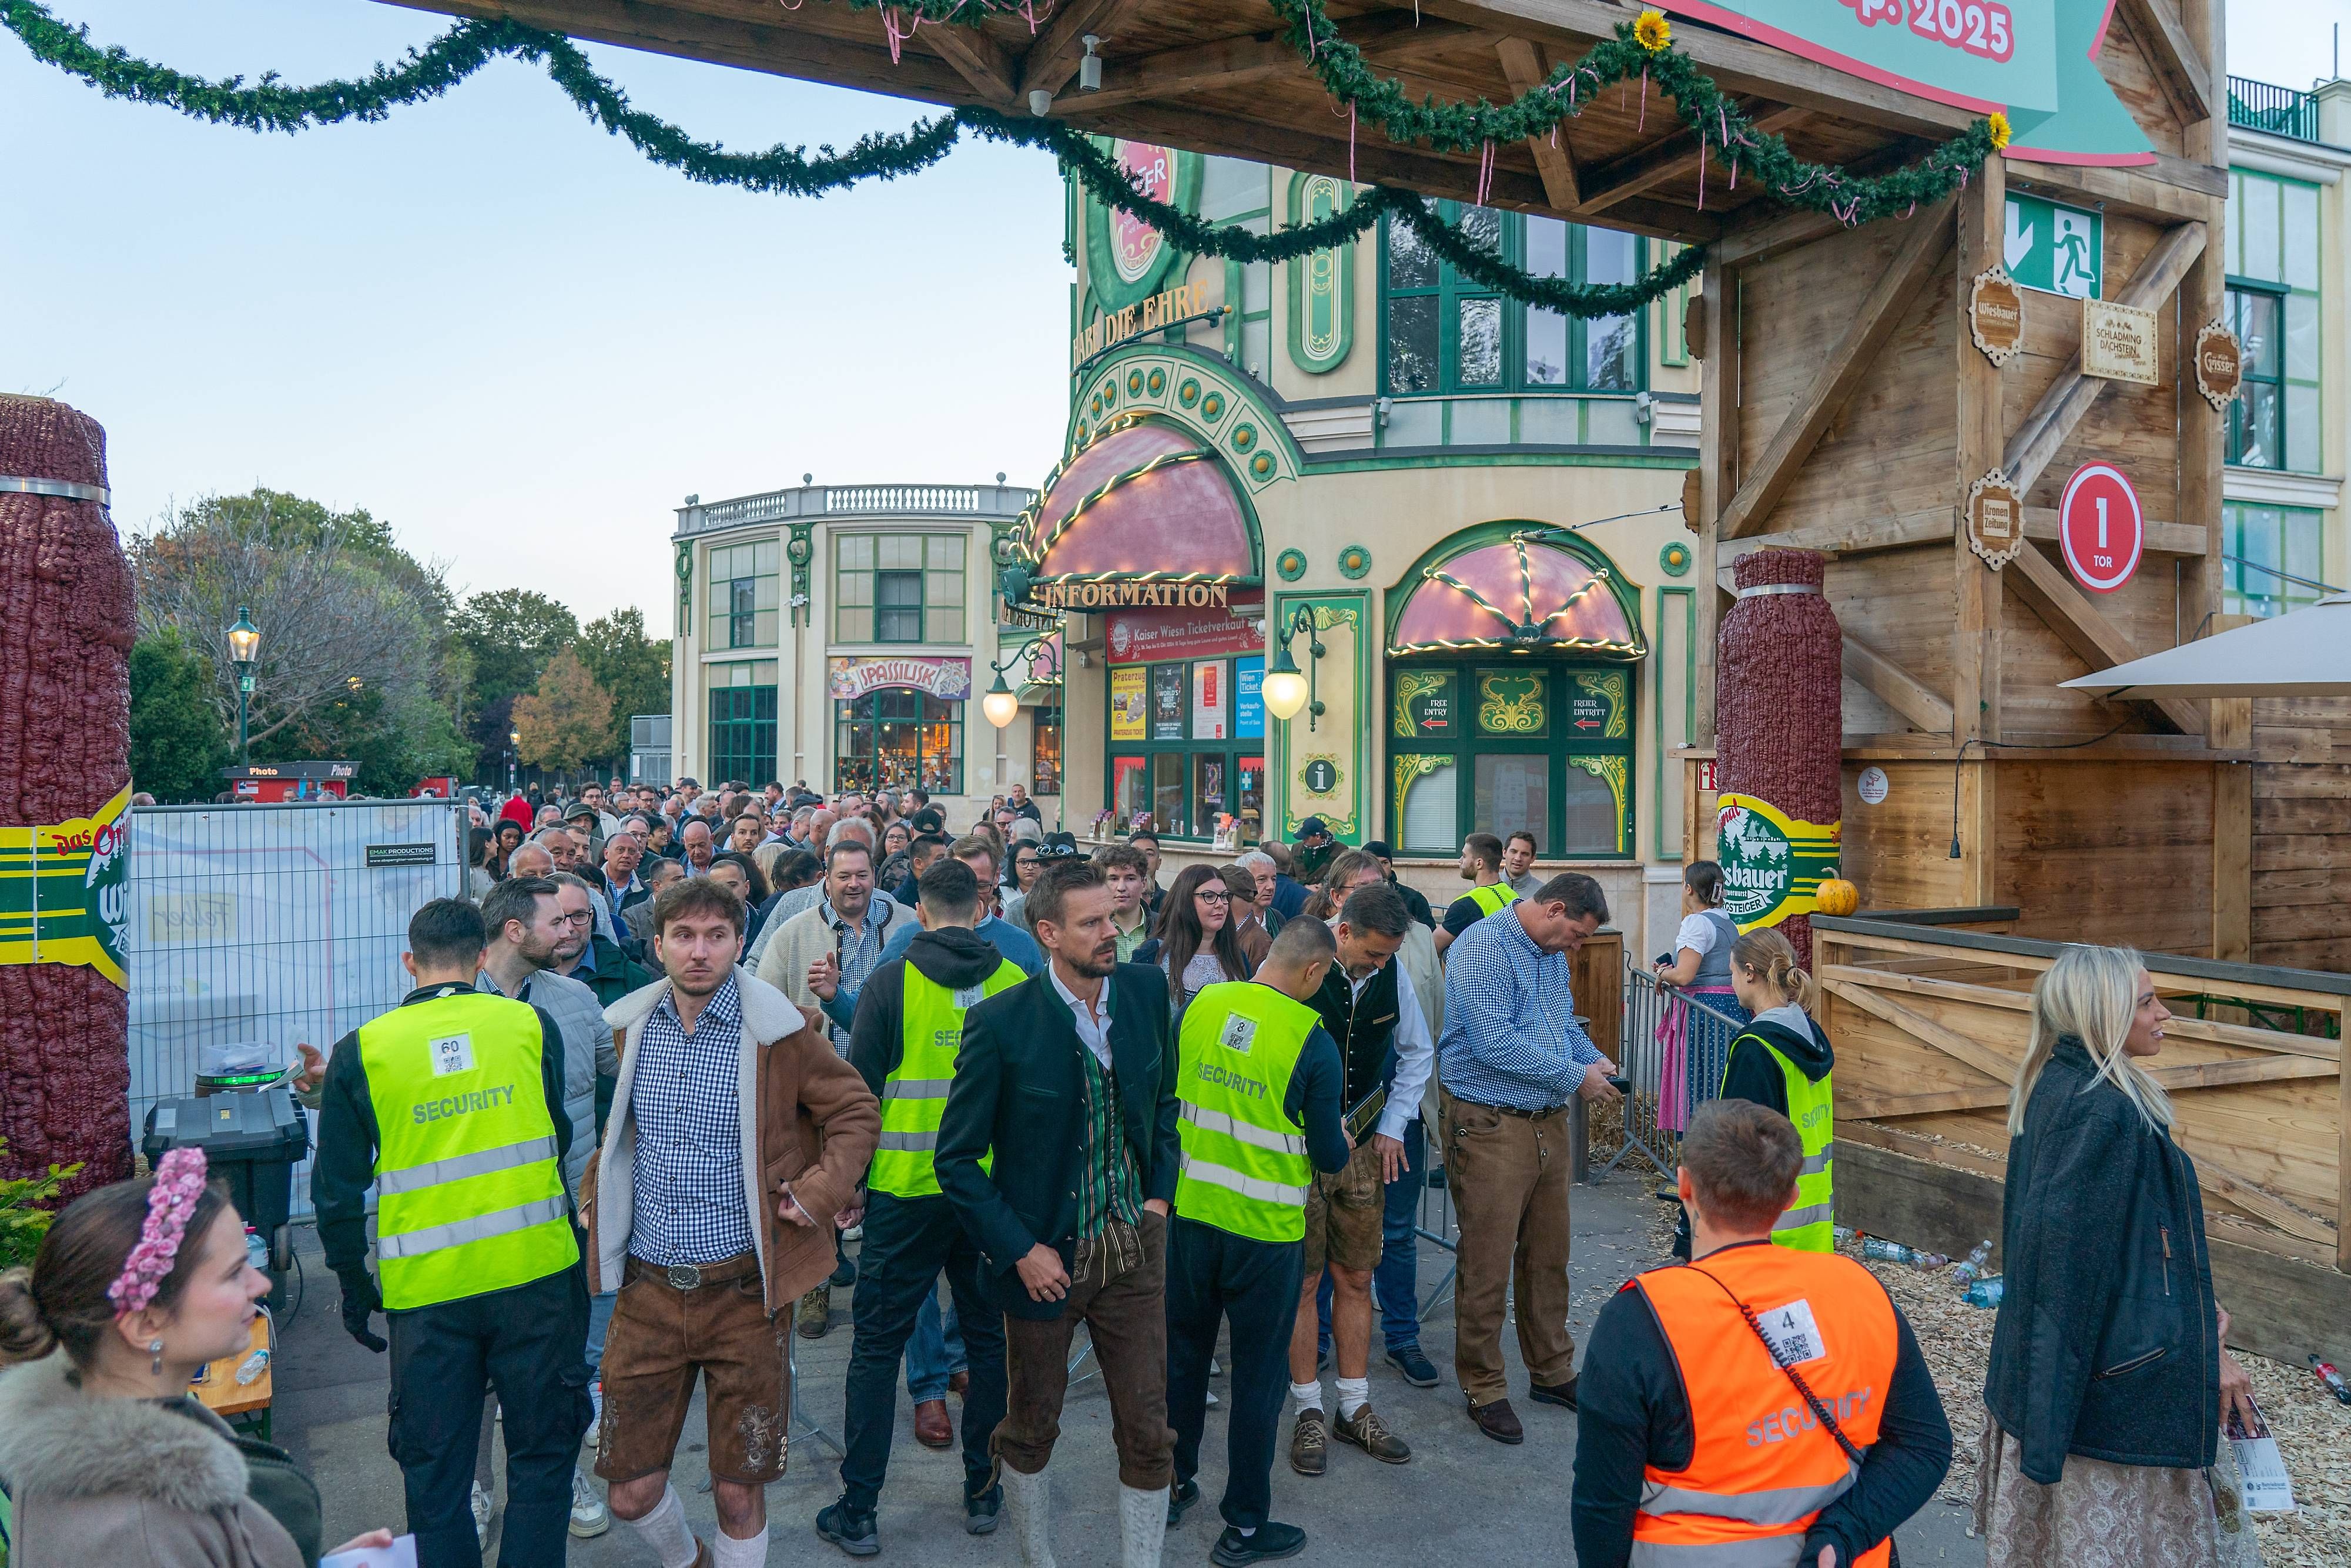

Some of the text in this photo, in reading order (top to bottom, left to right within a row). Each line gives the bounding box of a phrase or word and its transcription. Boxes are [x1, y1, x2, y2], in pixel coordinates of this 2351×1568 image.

[1914, 0, 2008, 54] 2025
[1978, 301, 2018, 320] Wiesbauer
[1073, 279, 1209, 368] HABE DIE EHRE
[2097, 328, 2142, 344] SCHLADMING
[2100, 340, 2136, 354] DACHSTEIN
[1984, 504, 2008, 517] Kronen
[1984, 517, 2008, 531] Zeitung
[2096, 497, 2107, 548] 1
[2094, 555, 2112, 568] TOR
[1044, 583, 1228, 608] INFORMATION
[1134, 616, 1245, 641] Kaiser Wiesn Ticketverkauf
[860, 661, 936, 686] SPASSILISK
[1113, 672, 1146, 682] Praterzug
[1241, 674, 1255, 682] Wien
[1241, 682, 1258, 691] Ticket
[1573, 699, 1597, 708] FREIER
[1573, 708, 1606, 716] EINTRITT
[249, 767, 278, 776] Photo
[330, 764, 353, 776] Photo
[1727, 889, 1747, 897] uerwurst
[1237, 1021, 1245, 1033] 8
[441, 1040, 459, 1054] 60
[1198, 1062, 1268, 1100] SECURITY
[413, 1084, 515, 1124] SECURITY
[1782, 1311, 1795, 1329] 4
[1746, 1386, 1871, 1447] SECURITY
